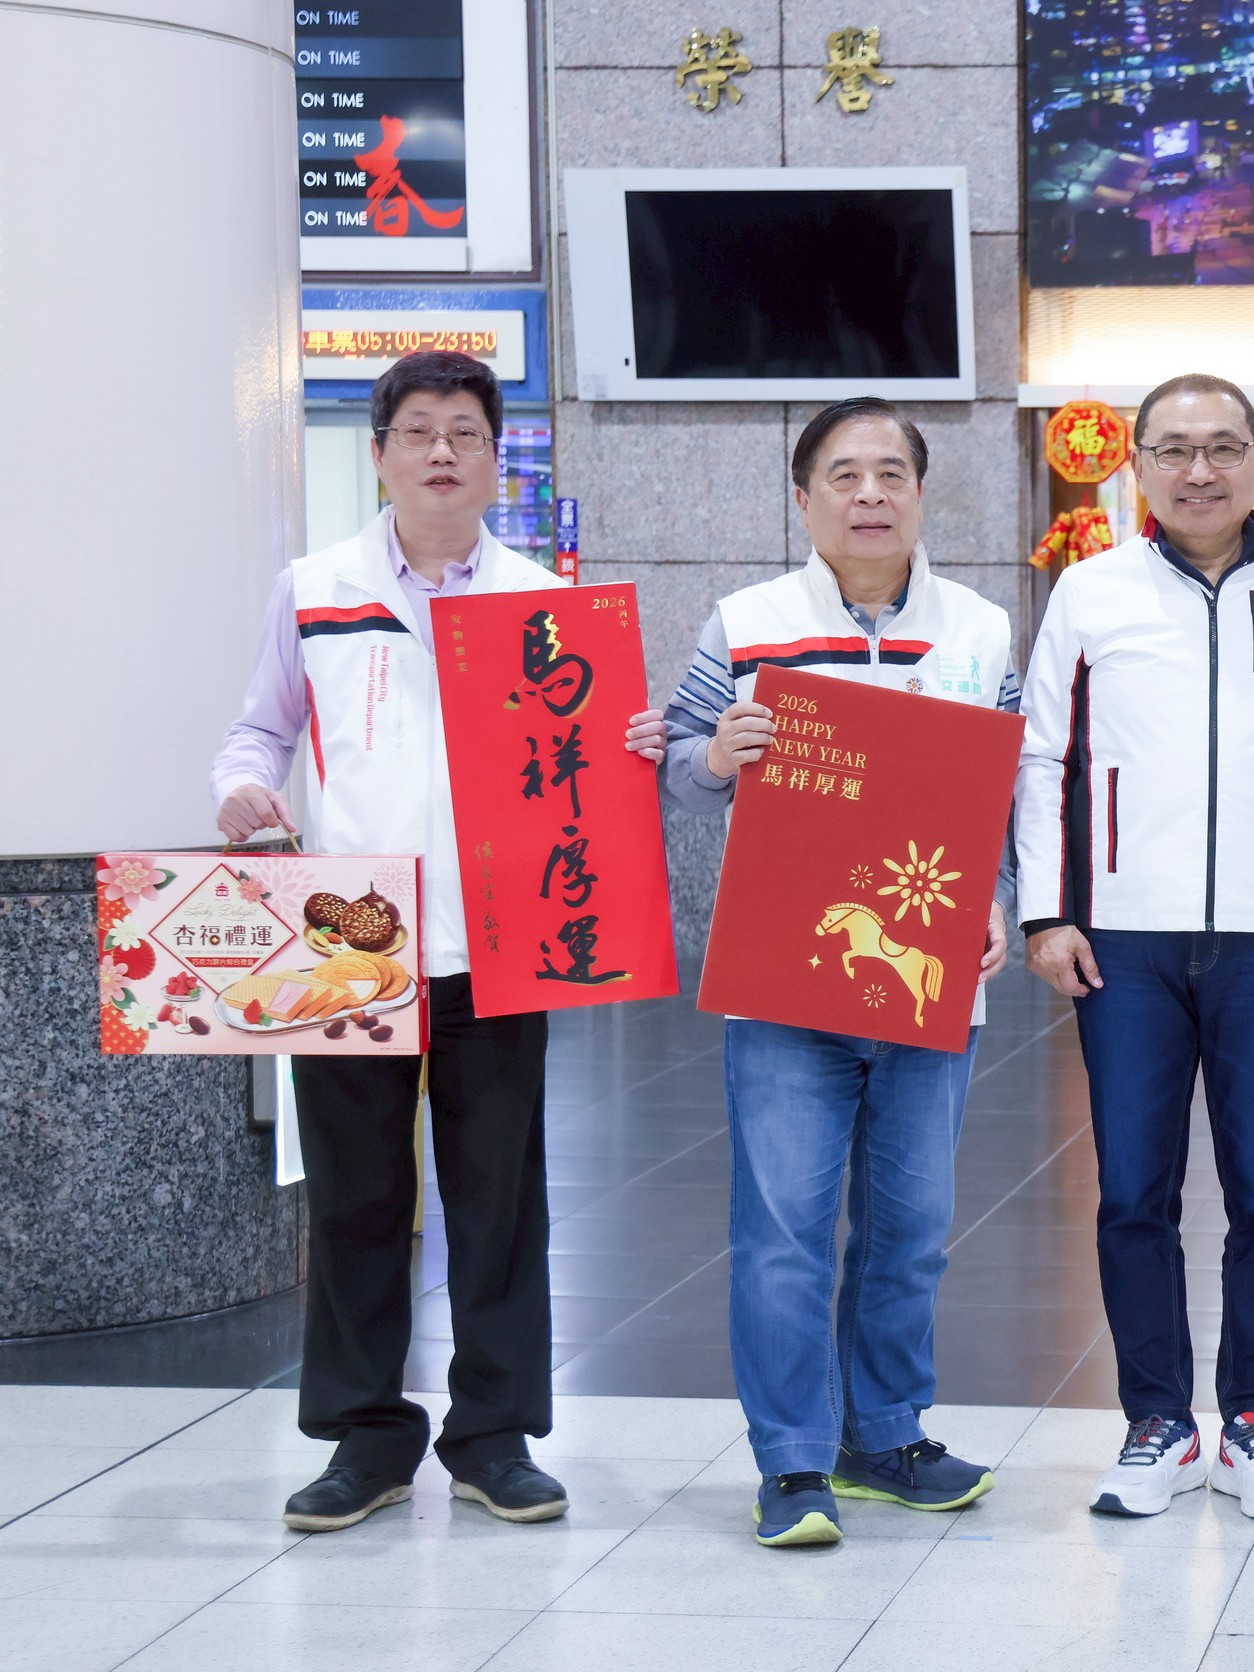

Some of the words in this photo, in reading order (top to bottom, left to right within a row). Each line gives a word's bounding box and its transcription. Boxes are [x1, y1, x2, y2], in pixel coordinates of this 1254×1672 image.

[296, 10, 320, 26] ON
[327, 10, 360, 26] TIME
[298, 50, 321, 65] ON
[329, 50, 361, 65] TIME
[676, 26, 895, 113] 榮譽
[301, 93, 325, 108] ON
[332, 92, 364, 108] TIME
[302, 132, 326, 147] ON
[333, 132, 365, 147] TIME
[303, 171, 327, 187] ON
[334, 171, 367, 187] TIME
[354, 114, 464, 237] 春
[304, 211, 328, 226] ON
[336, 211, 367, 226] TIME
[302, 331, 497, 352] 車票05:00-23:50
[1067, 418, 1106, 455] 福
[592, 596, 626, 610] 2026
[381, 645, 390, 662] New
[380, 663, 389, 685] Taipei
[377, 686, 388, 702] City
[777, 693, 818, 715] 2026
[365, 704, 375, 752] Department
[775, 715, 837, 740] HAPPY
[769, 736, 815, 758] NEW
[819, 745, 867, 769] YEAR
[761, 763, 862, 801] 馬祥厚運
[503, 610, 633, 986] 馬祥厚運
[172, 924, 273, 946] 杏福禮運
